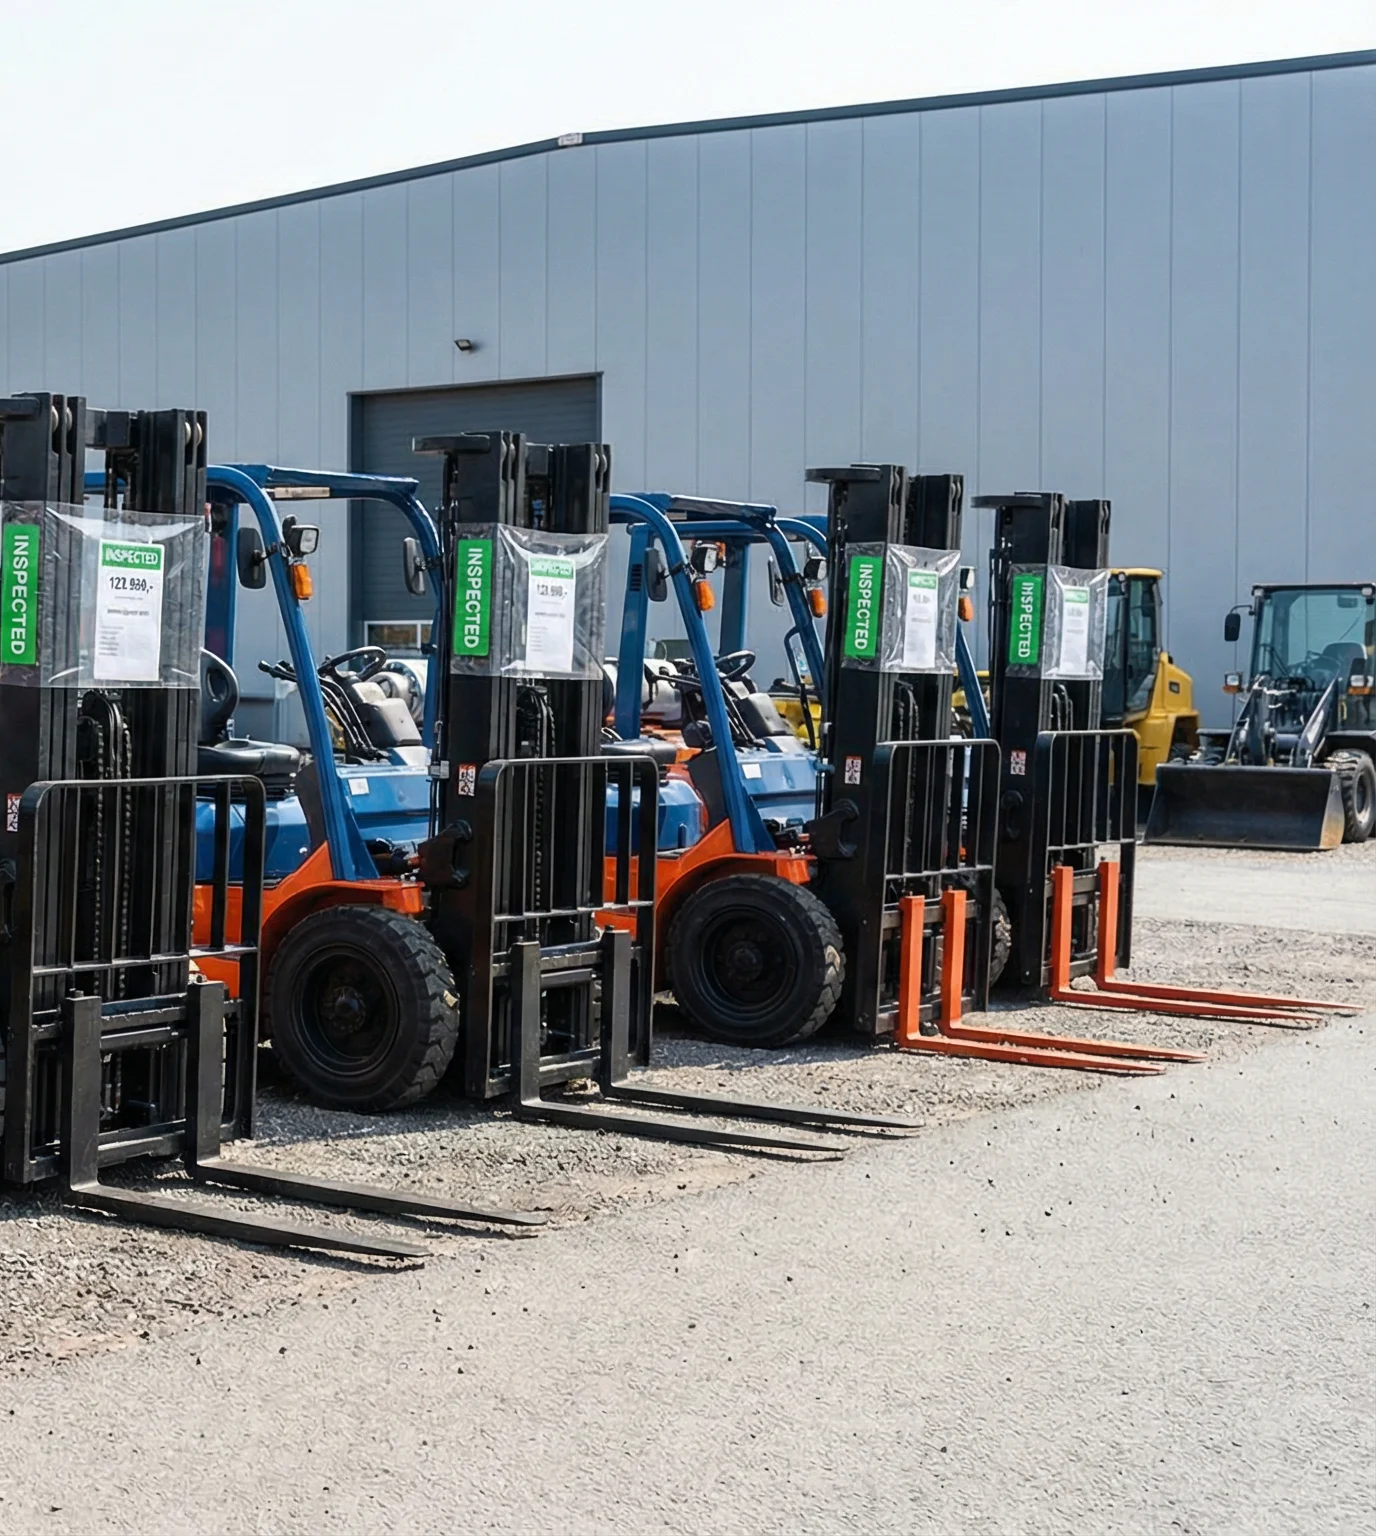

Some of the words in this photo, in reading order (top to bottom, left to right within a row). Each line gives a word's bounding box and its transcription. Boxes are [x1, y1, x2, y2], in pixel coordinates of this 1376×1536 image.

[10, 535, 29, 655] INSPECTED
[105, 547, 159, 565] INSPECTED
[464, 547, 483, 648] INSPECTED
[854, 563, 873, 649] INSPECTED
[1018, 582, 1034, 657] INSPECTED
